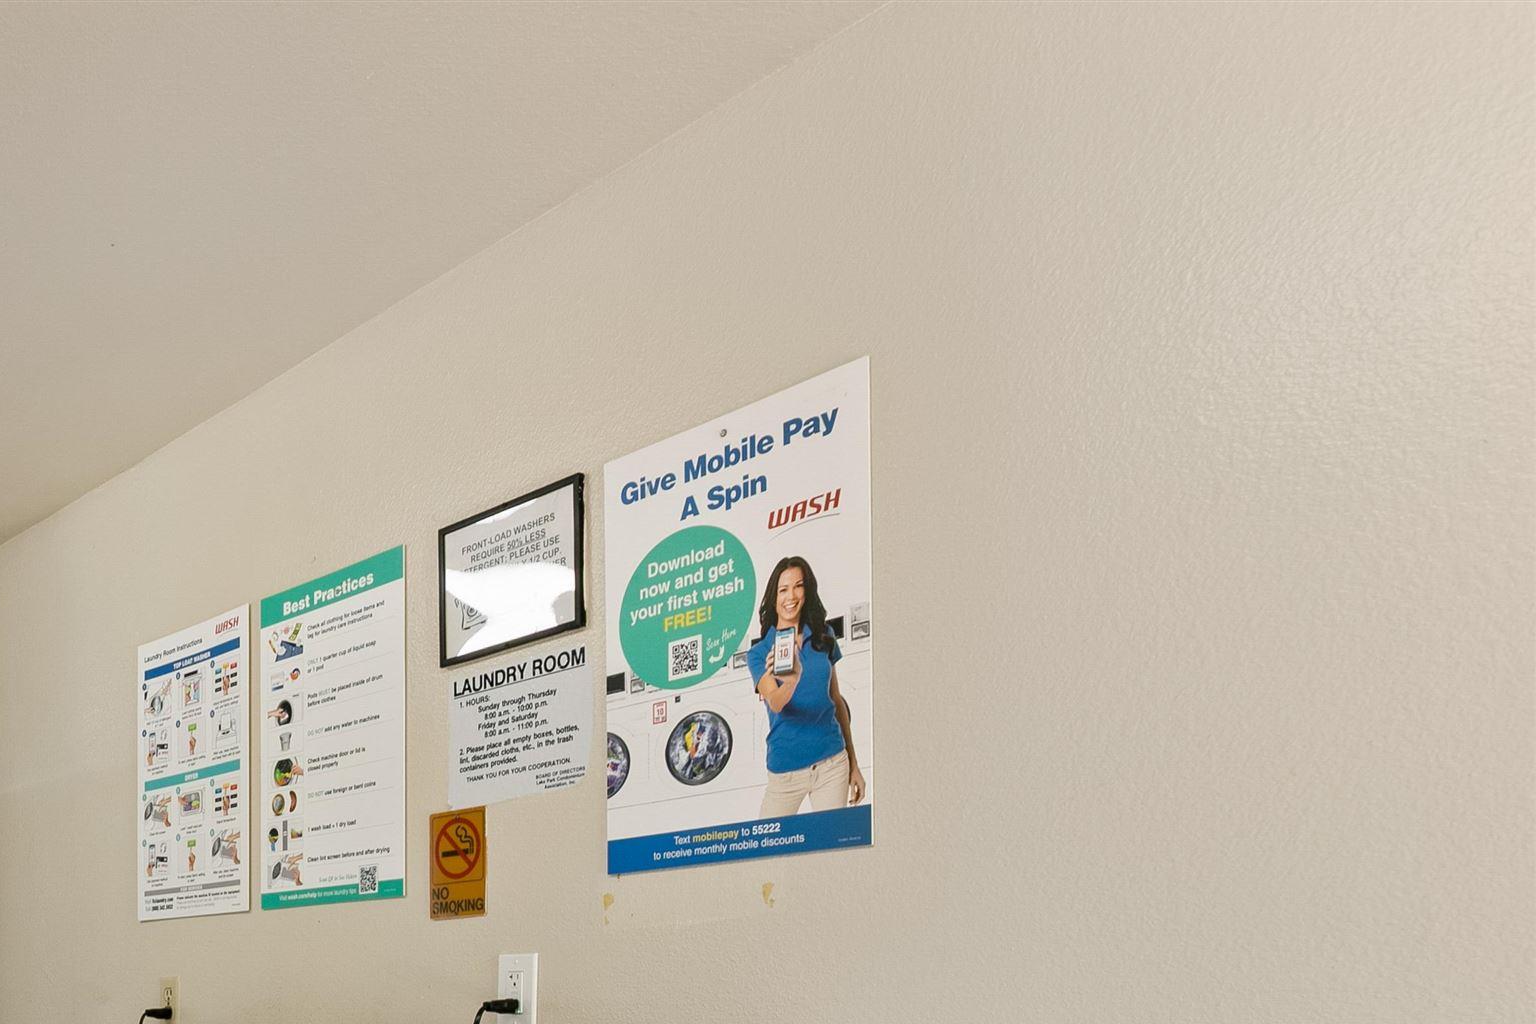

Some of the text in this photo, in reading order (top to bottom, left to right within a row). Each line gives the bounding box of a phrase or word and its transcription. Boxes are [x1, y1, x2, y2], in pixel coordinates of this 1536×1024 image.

[621, 408, 838, 506] Give Mobile Pay
[680, 474, 767, 520] A Spin
[768, 488, 841, 530] WASH
[462, 513, 555, 555] FRONT-LOAD WASHERS
[471, 544, 505, 563] REQUIRE
[507, 538, 523, 550] 50%
[525, 529, 546, 543] LESS
[509, 542, 541, 561] PLEASE
[544, 535, 560, 547] USE
[648, 540, 724, 579] Download
[640, 558, 734, 600] now and get
[283, 572, 374, 616] Best Practices
[630, 577, 744, 626] your first wash
[215, 616, 239, 635] WASH
[307, 623, 320, 631] Check
[327, 615, 343, 625] clothing
[347, 613, 373, 625] instructions
[663, 606, 712, 632] FREE!
[144, 638, 203, 663] Laundry Room Instructions
[779, 648, 788, 658] 10
[454, 647, 585, 697] LAUNDRY ROOM
[466, 695, 491, 707] HOURS:
[478, 688, 557, 713] Sunday through Thursday
[498, 710, 510, 718] a.m.
[518, 703, 534, 712] 10:00
[535, 700, 548, 710] p.m.
[656, 707, 664, 716] 10
[478, 712, 538, 731] Friday and Saturday
[498, 728, 510, 736] a.m.
[518, 722, 534, 731] 11:00
[535, 719, 548, 728] p.m.
[460, 748, 464, 756] 2.
[466, 743, 485, 753] Please
[487, 740, 502, 751] place
[513, 735, 531, 746] empty
[534, 730, 553, 740] boxes,
[556, 724, 579, 735] bottles,
[460, 756, 470, 765] lint,
[472, 750, 499, 762] discarded
[501, 746, 520, 756] cloths,
[545, 738, 555, 746] the
[557, 734, 573, 744] trash
[321, 752, 338, 762] machine
[460, 756, 517, 773] containers provided.
[466, 772, 484, 783] THANK
[486, 770, 497, 779] YOU
[499, 768, 509, 776] FOR
[511, 765, 526, 775] YOUR
[560, 766, 585, 775] DIRECTORS
[674, 822, 781, 846] Text mobilepay to 55222
[307, 855, 319, 863] Clean
[375, 846, 390, 855] drying
[654, 832, 804, 861] to receive monthly mobile discounts
[432, 887, 449, 900] NO
[432, 898, 484, 914] SMOKING
